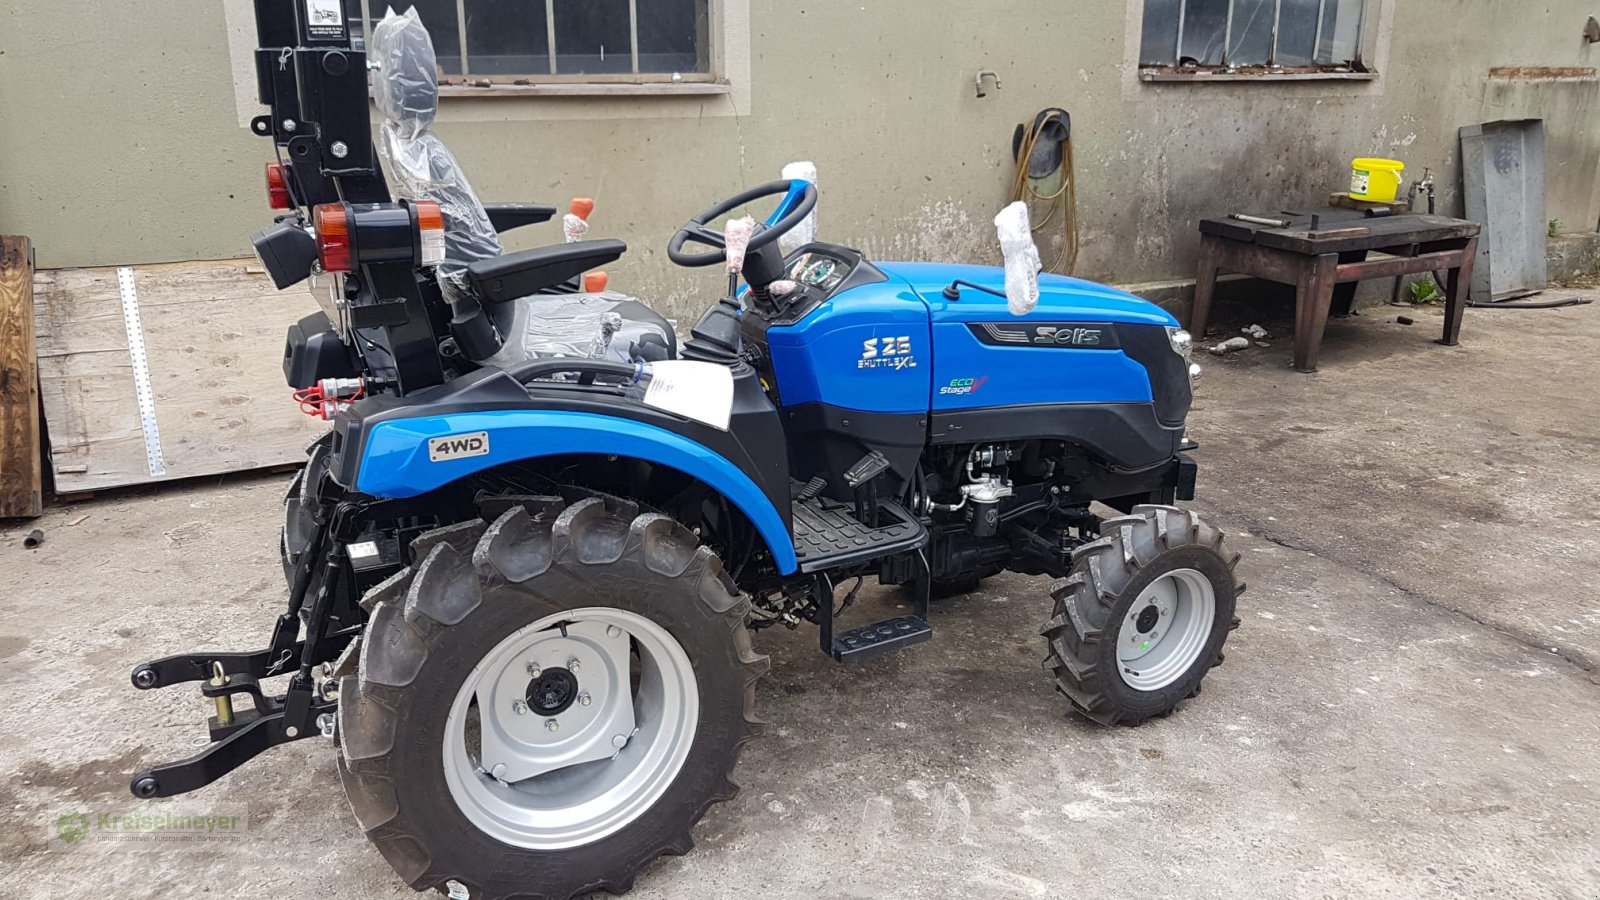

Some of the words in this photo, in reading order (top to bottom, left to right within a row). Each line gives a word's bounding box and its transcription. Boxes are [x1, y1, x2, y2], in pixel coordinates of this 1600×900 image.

[1034, 326, 1101, 345] Solis
[862, 338, 878, 359] S
[949, 378, 974, 387] ECO
[436, 438, 483, 454] 4WD
